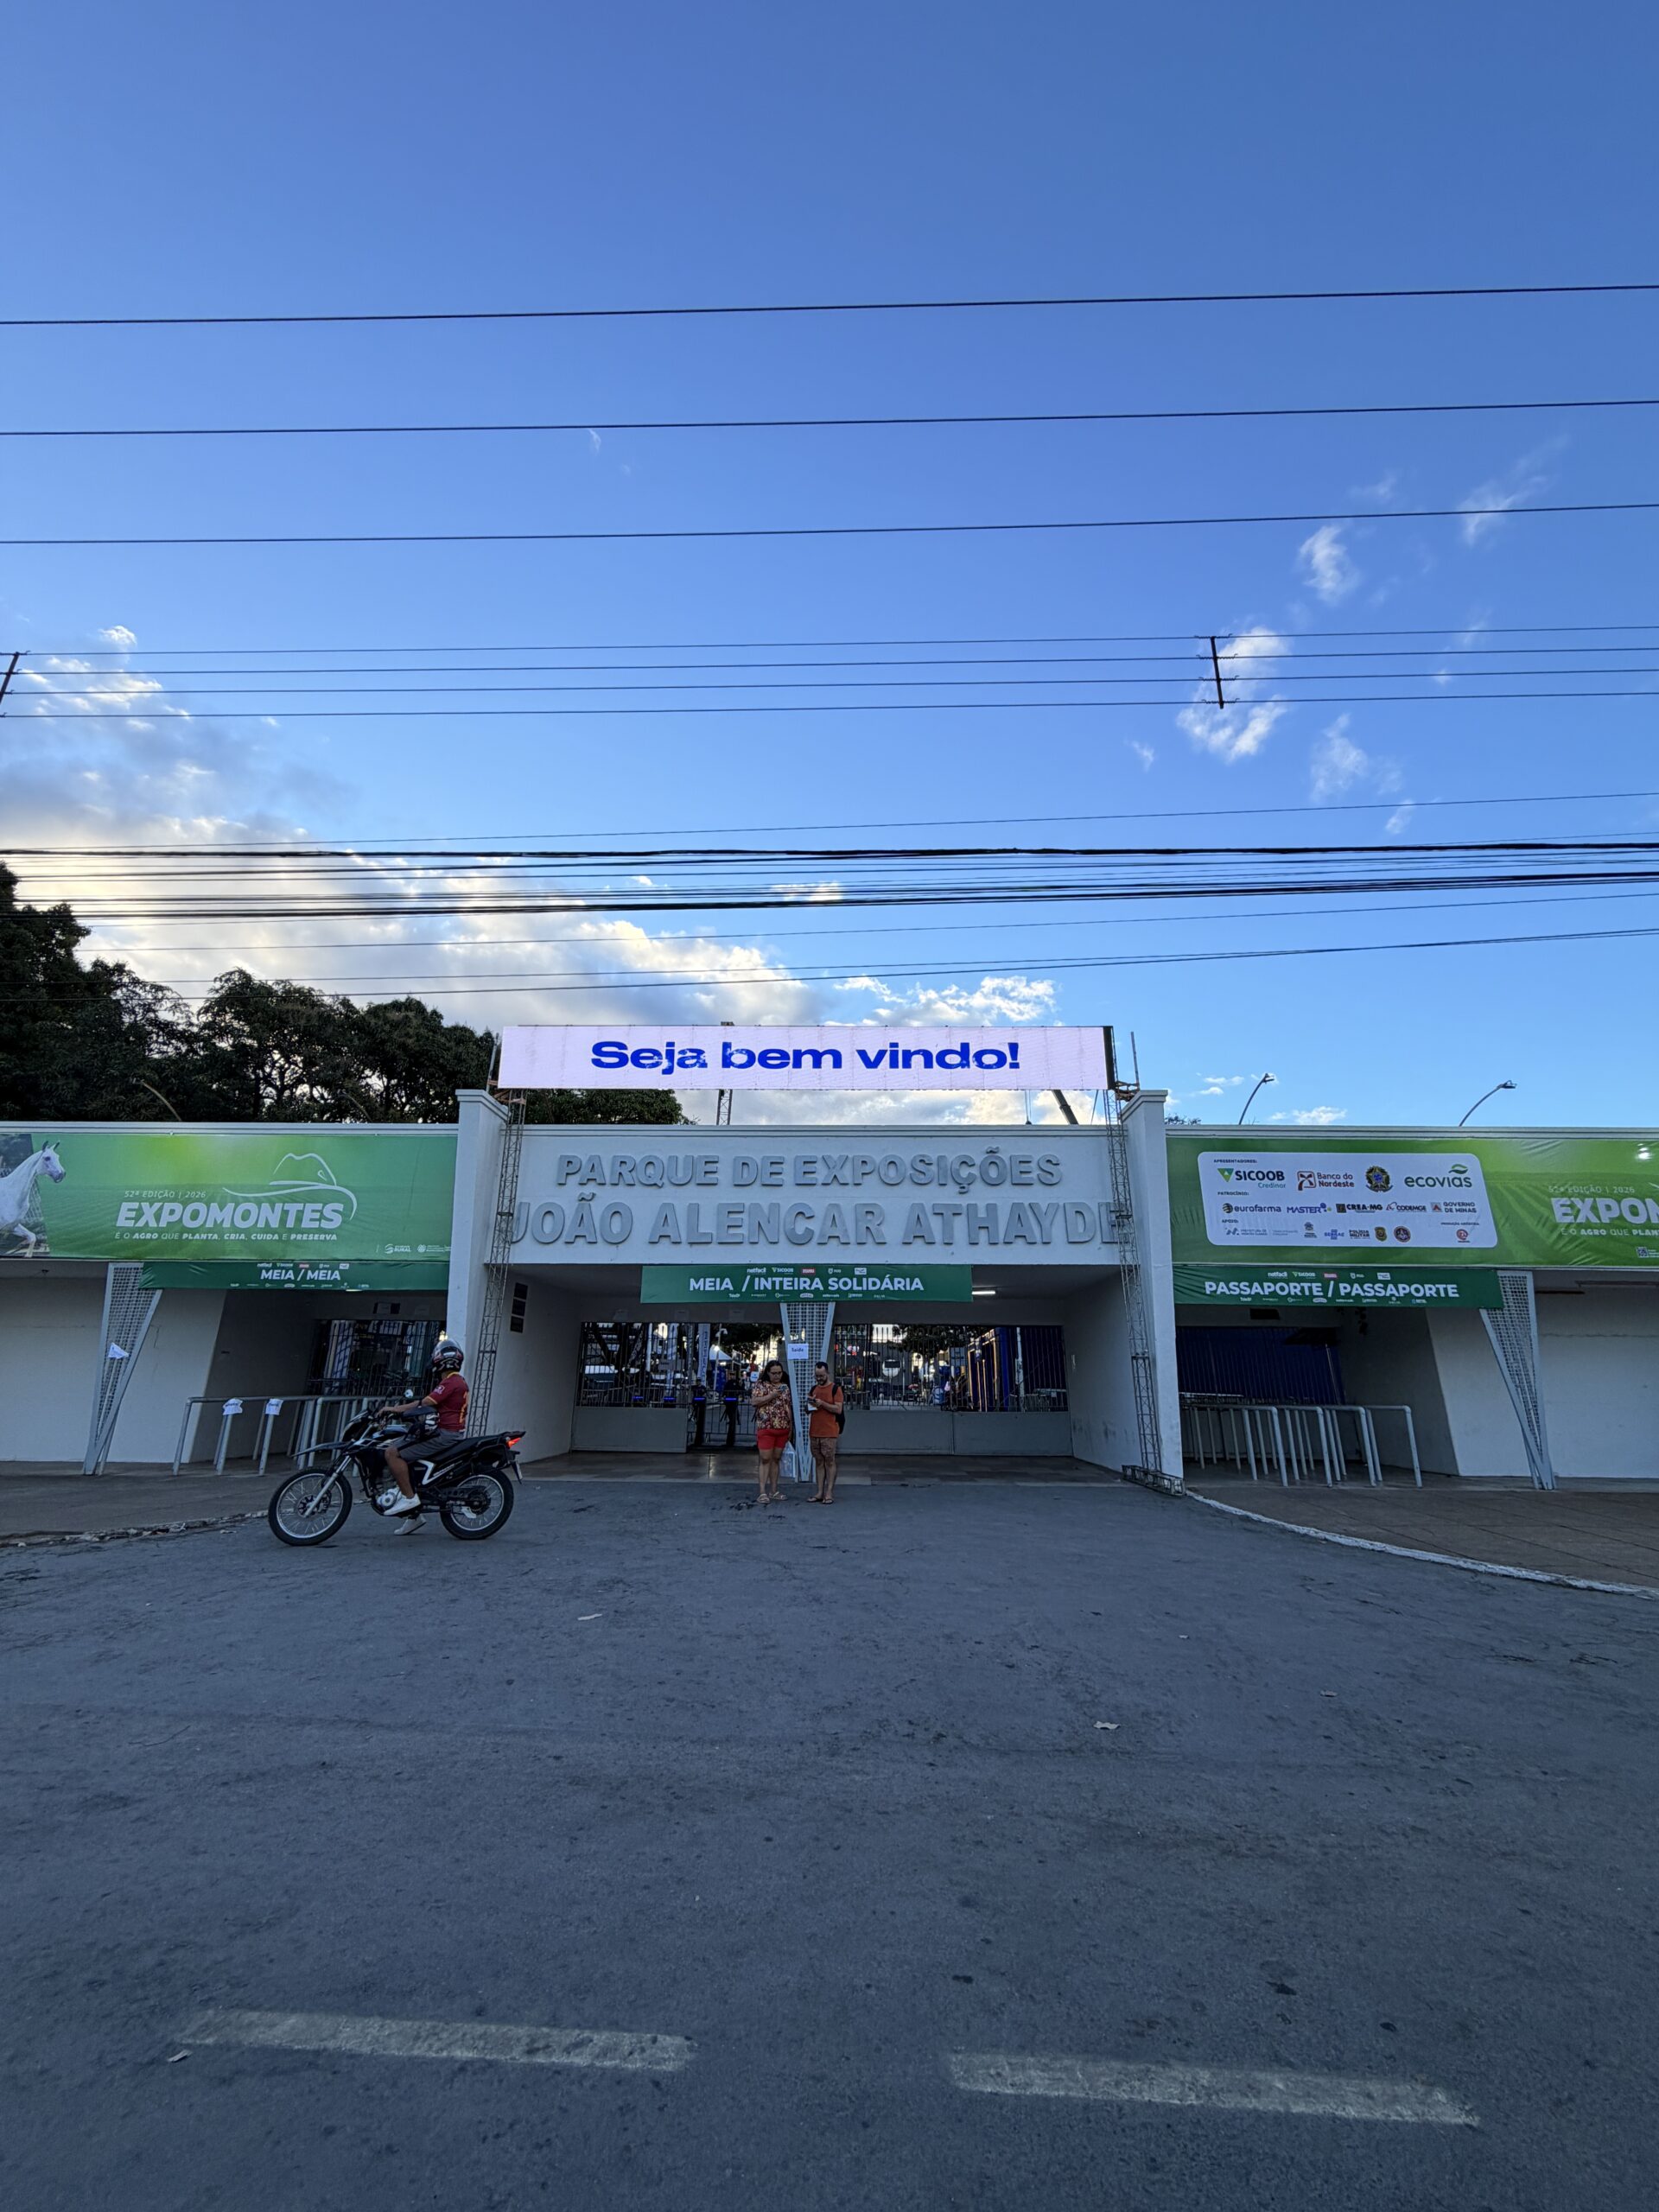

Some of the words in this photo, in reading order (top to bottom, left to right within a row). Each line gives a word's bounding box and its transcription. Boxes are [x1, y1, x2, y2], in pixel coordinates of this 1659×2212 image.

[591, 1041, 708, 1075] Seja
[721, 1041, 842, 1069] bem
[856, 1042, 1020, 1069] vindo!
[557, 1154, 719, 1187] PARQUE
[734, 1155, 785, 1185] DE
[795, 1146, 1062, 1194] EXPOSIÇÕES
[1235, 1170, 1285, 1181] SICOOB
[1404, 1176, 1472, 1188] ecovias
[142, 1190, 175, 1199] EDIÇÃO
[116, 1202, 344, 1229] EXPOMONTES
[1234, 1205, 1281, 1213] eurofarma
[510, 1192, 633, 1244] JOÃO
[648, 1202, 887, 1245] ALENCAR
[260, 1269, 295, 1280] MEIA
[306, 1270, 341, 1281] MEIA
[690, 1278, 734, 1291] MEIA
[754, 1277, 824, 1291] INTEIRA
[828, 1274, 925, 1291] SOLIDÁRIA
[1205, 1281, 1324, 1296] PASSAPORTE
[1339, 1283, 1459, 1297] PASSAPORTE
